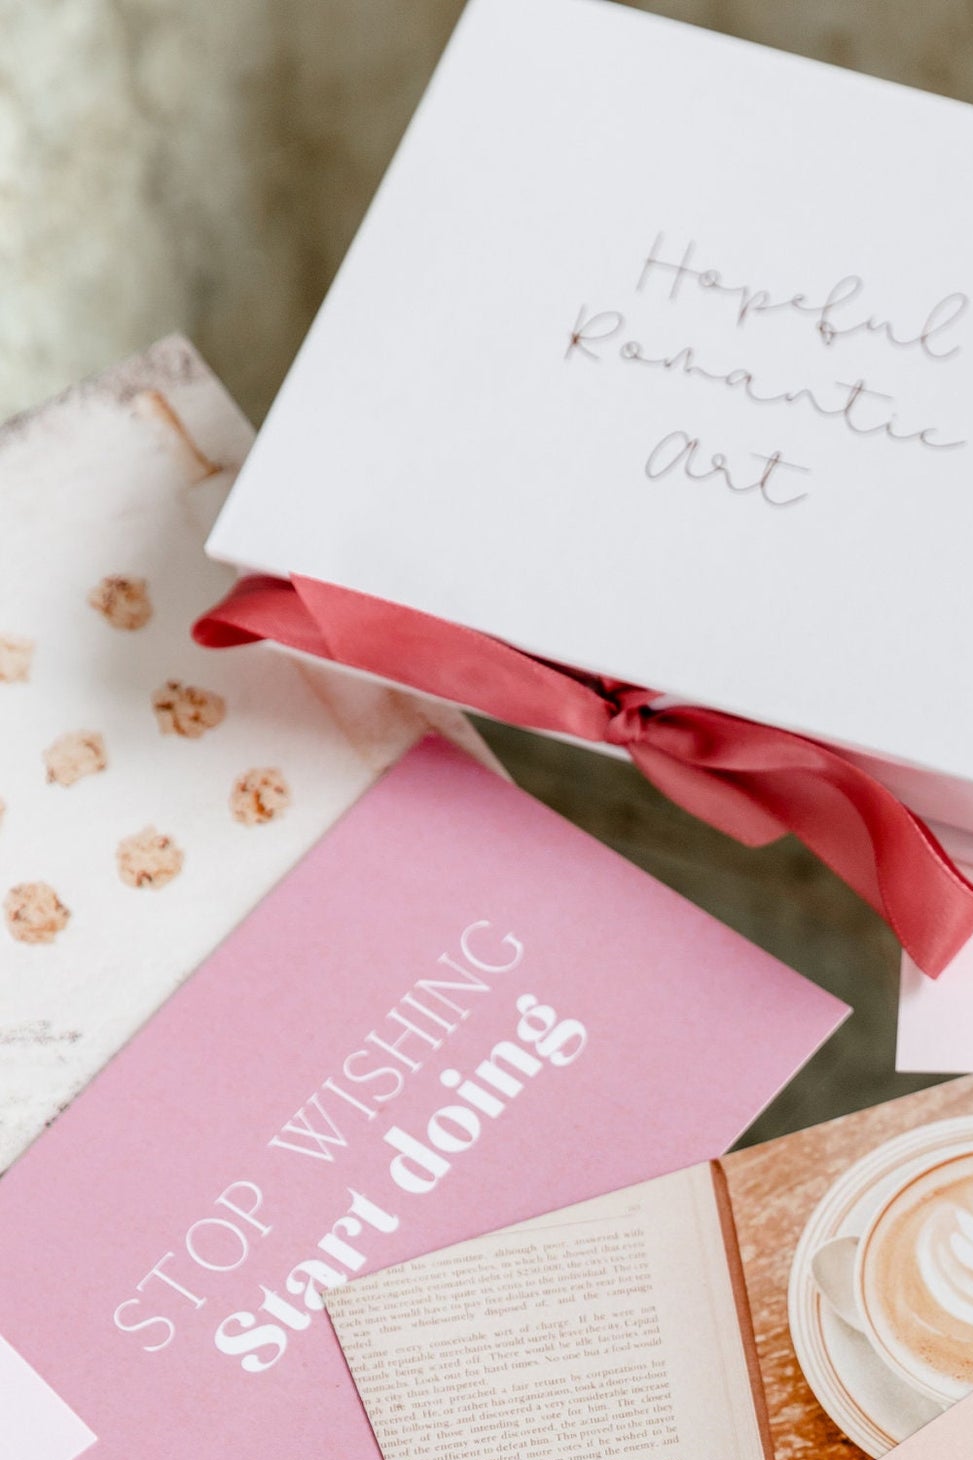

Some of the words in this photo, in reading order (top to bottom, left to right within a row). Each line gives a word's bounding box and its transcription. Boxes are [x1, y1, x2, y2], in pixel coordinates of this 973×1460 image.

[564, 305, 966, 447] Romantic
[637, 231, 968, 357] Hopeful
[113, 1181, 272, 1352] STOP
[268, 919, 524, 1163] WISHING
[214, 1187, 400, 1372] Start
[384, 993, 588, 1194] doing
